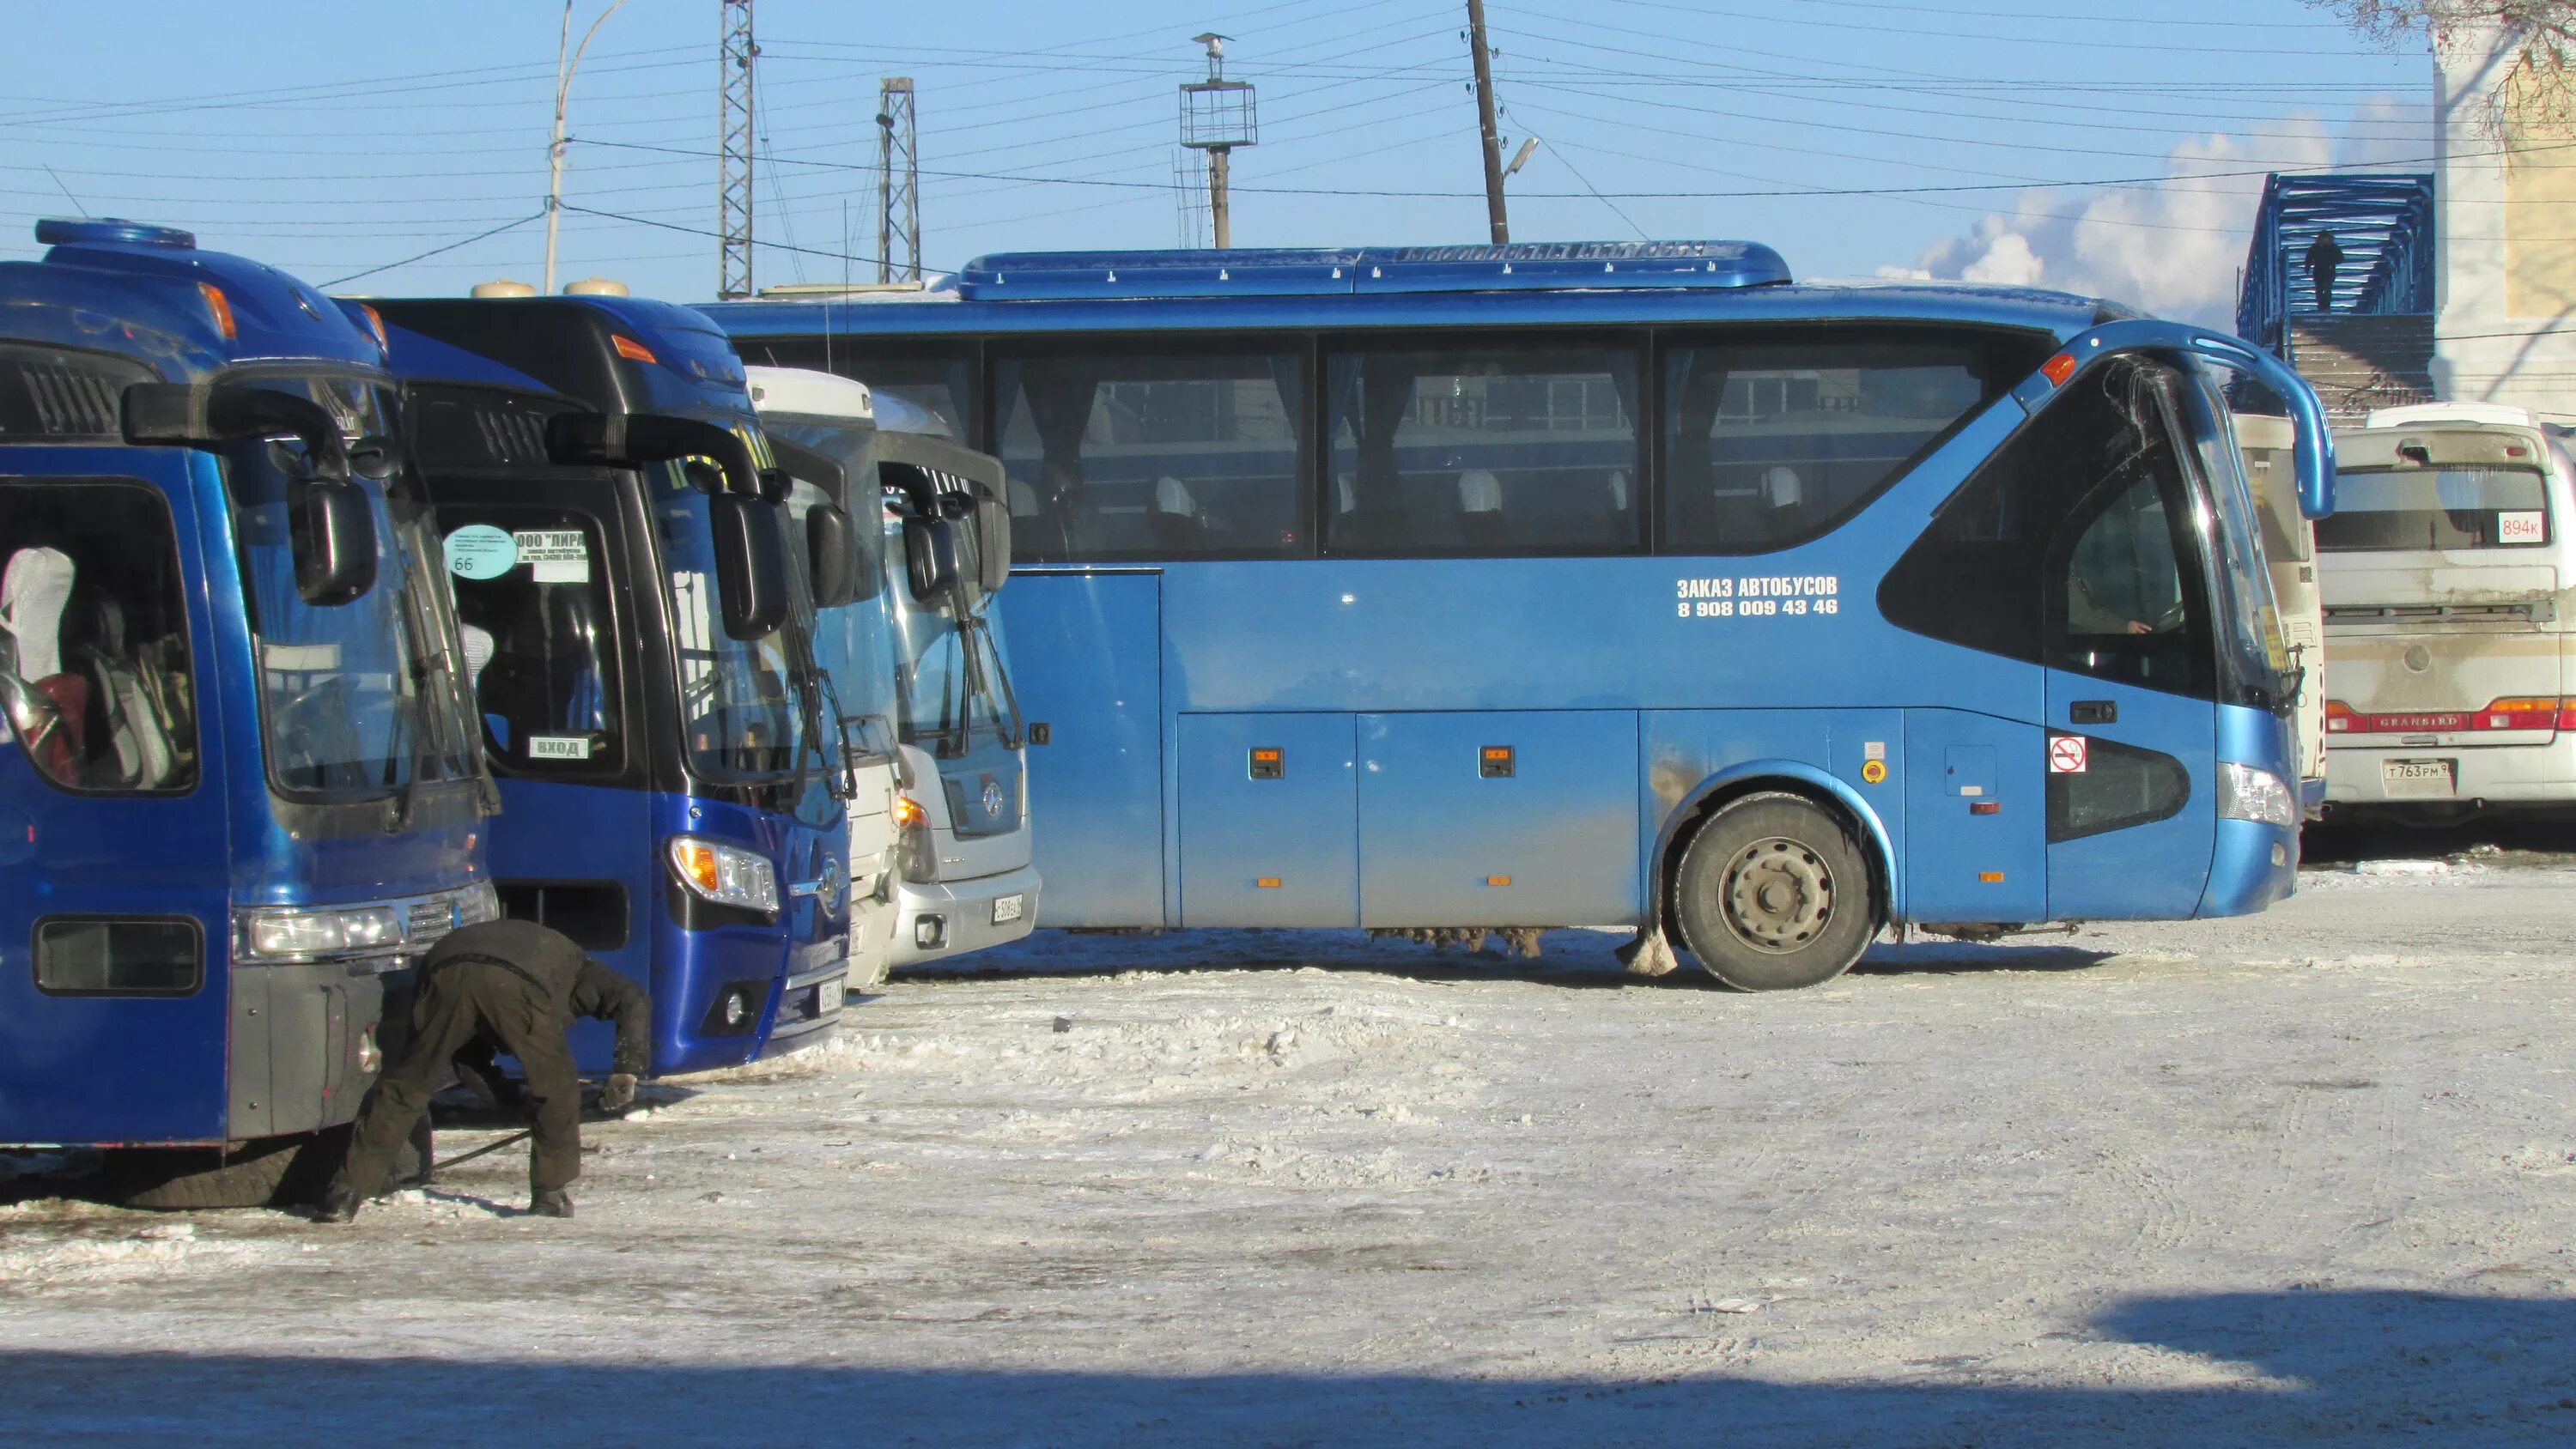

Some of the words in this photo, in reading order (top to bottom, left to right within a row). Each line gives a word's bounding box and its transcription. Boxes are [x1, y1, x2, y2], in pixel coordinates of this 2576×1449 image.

[517, 533, 543, 548] ООО
[454, 557, 473, 571] 66
[1676, 578, 1733, 598] ЗАКАЗ
[1738, 576, 1838, 597] АВТОБУСОВ
[1677, 602, 1691, 617] 8
[1696, 601, 1734, 617] 908
[1739, 600, 1777, 616] 009
[1782, 599, 1807, 615] 43
[1813, 599, 1838, 615] 46
[2380, 717, 2458, 727] GRANBIRD
[538, 741, 580, 756] ВХОД
